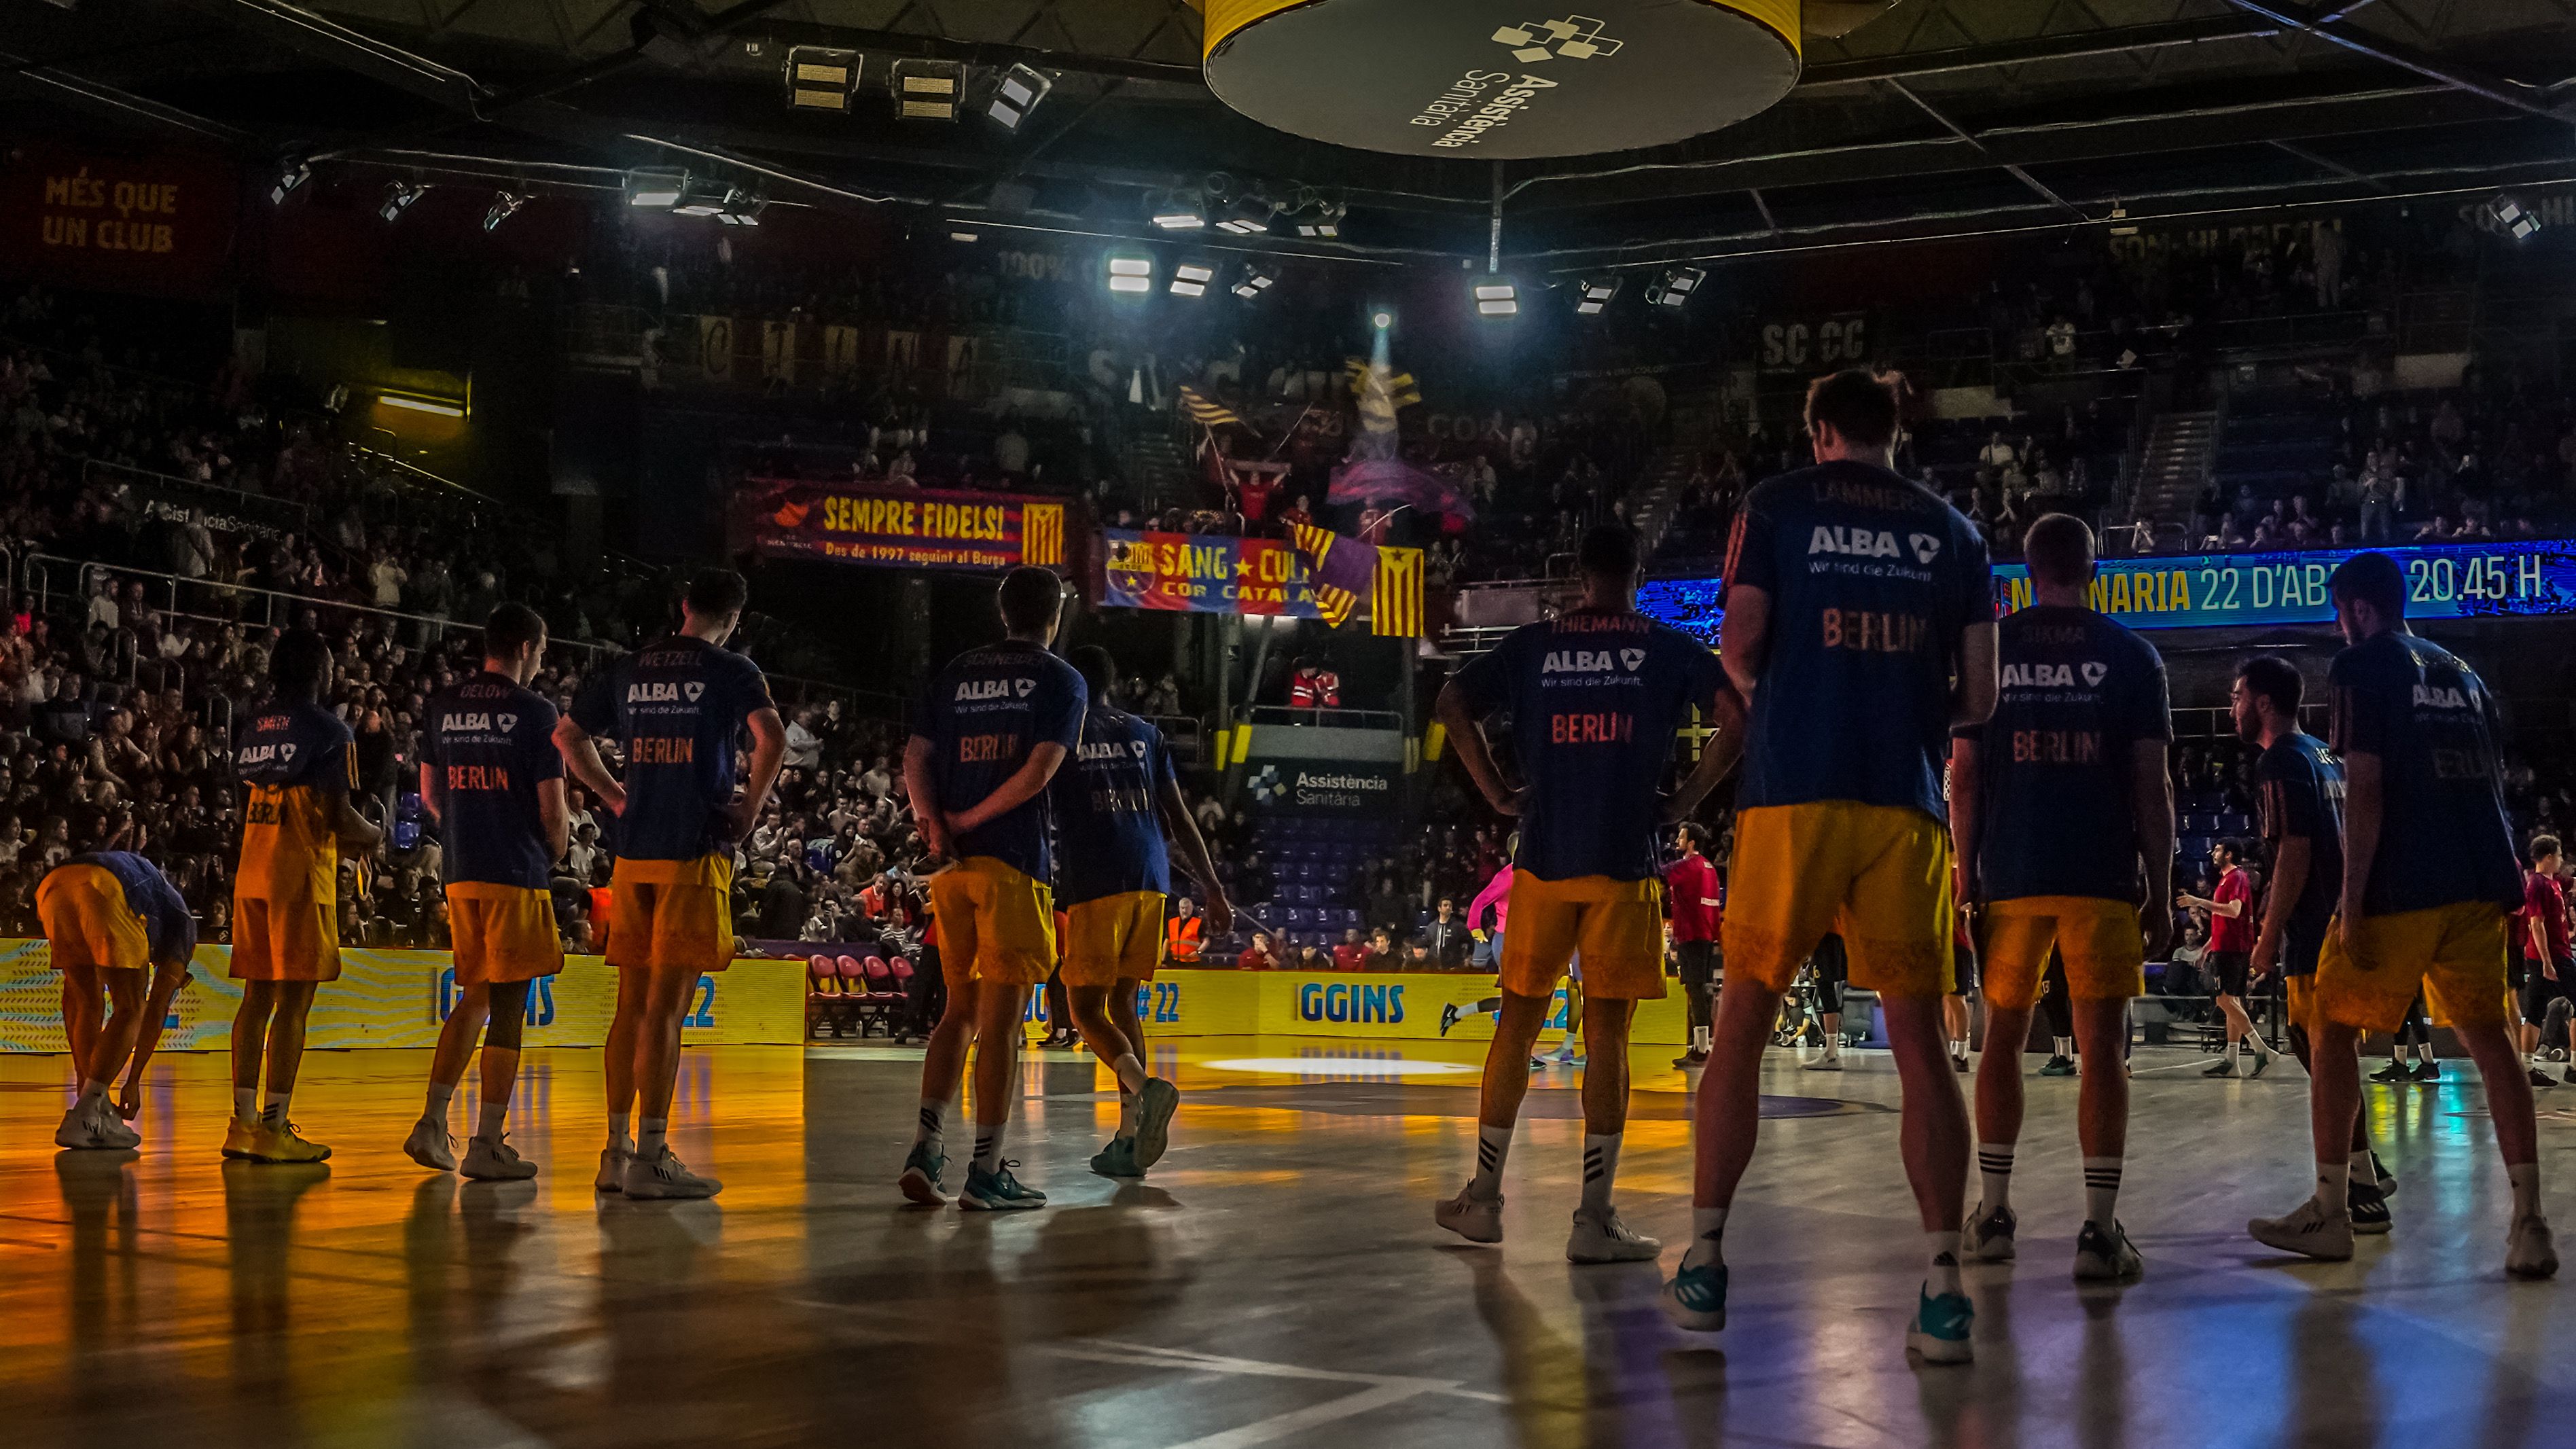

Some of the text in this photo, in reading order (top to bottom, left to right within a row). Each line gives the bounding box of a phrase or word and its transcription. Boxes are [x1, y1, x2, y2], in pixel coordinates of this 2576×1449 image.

[1410, 70, 1510, 126] Sanitària
[1431, 74, 1559, 147] Assistència
[46, 166, 177, 217] MÉS QUE
[43, 215, 173, 252] UN CLUB
[823, 496, 1004, 541] SEMPRE FIDELS!
[826, 543, 846, 556] Des
[851, 545, 865, 558] de
[872, 546, 904, 560] 1997
[909, 551, 952, 565] seguint
[957, 551, 968, 563] al
[1808, 526, 1901, 558] ALBA
[1160, 544, 1228, 579] SANG
[2090, 555, 2541, 613] NARIA 22 D'AB 20.45 H
[1552, 615, 1649, 633] THIEMANN
[1823, 608, 1927, 652] BERLIN
[1541, 650, 1614, 674] ALBA
[2001, 664, 2075, 687] ALBA
[628, 683, 679, 703] ALBA
[954, 679, 1009, 701] ALBA
[1542, 679, 1556, 687] Wir
[1560, 678, 1582, 686] sind
[1586, 677, 1600, 685] die
[442, 713, 490, 732] ALBA
[1552, 712, 1633, 744] BERLIN
[632, 737, 694, 764] BERLIN
[1078, 743, 1127, 762] ALBA
[2013, 730, 2102, 763] BERLIN
[448, 766, 508, 791] BERLIN
[1296, 771, 1388, 790] Assistència
